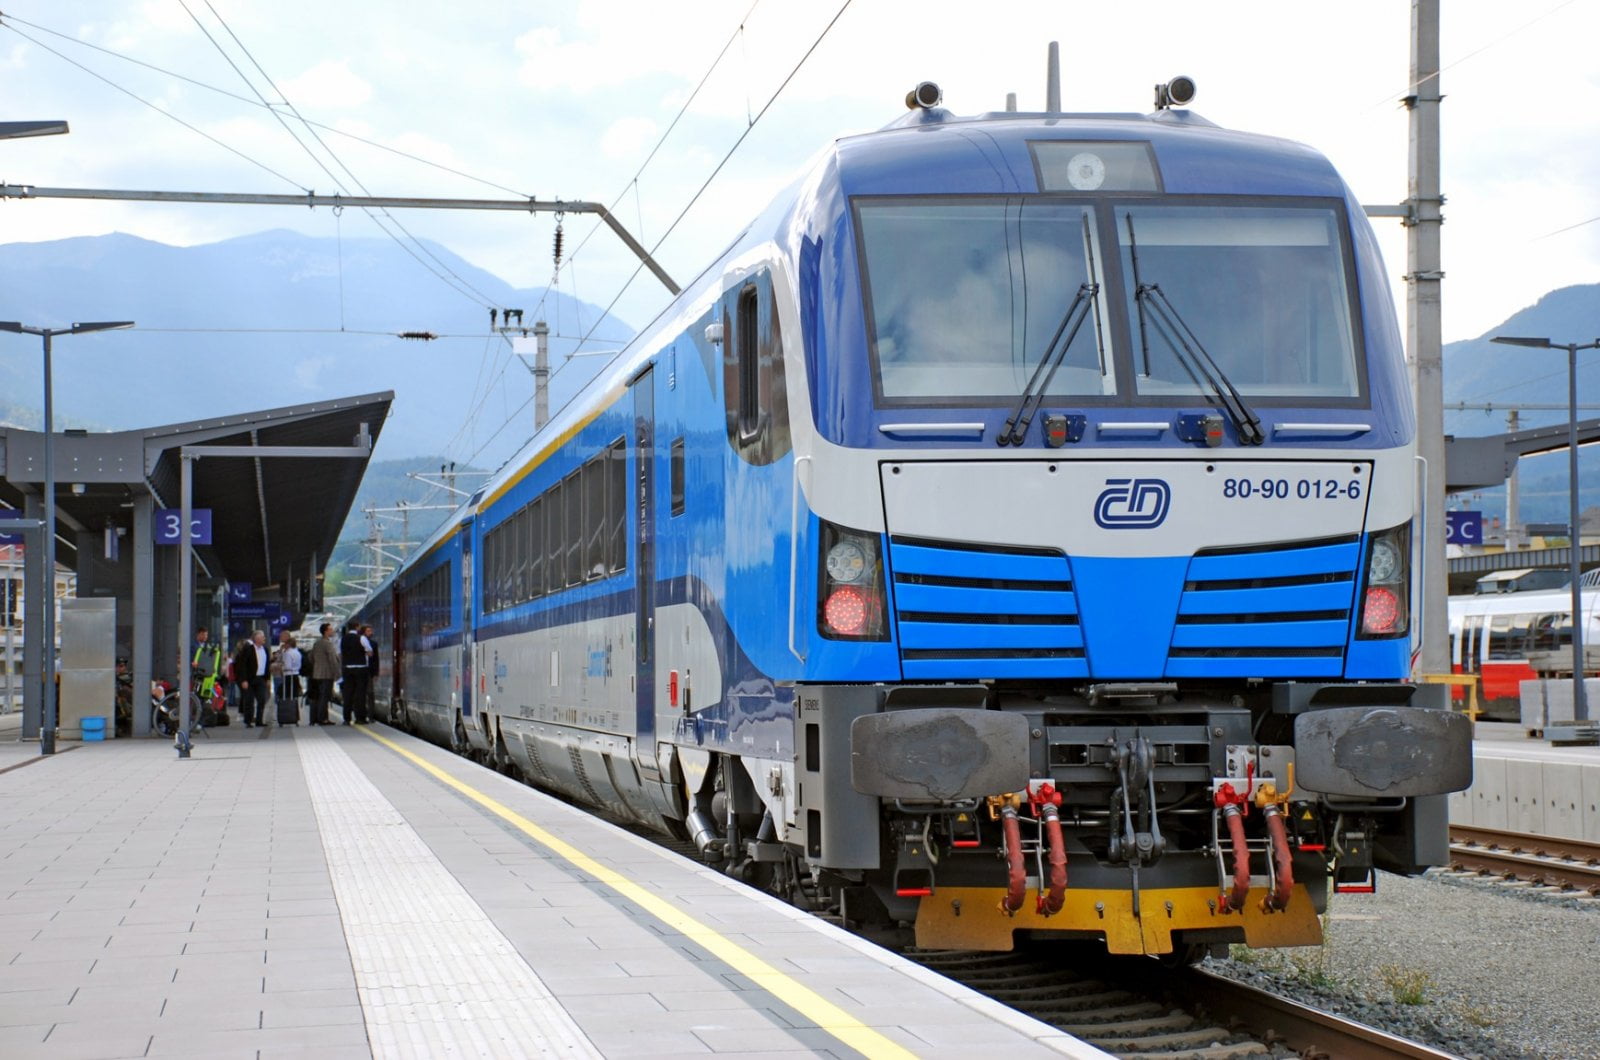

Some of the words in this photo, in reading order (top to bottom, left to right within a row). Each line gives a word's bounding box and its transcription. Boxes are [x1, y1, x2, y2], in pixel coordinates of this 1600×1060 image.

[1223, 479, 1289, 498] 80-90
[1296, 479, 1361, 498] 012-6
[165, 515, 180, 538] 3
[1460, 521, 1474, 539] C
